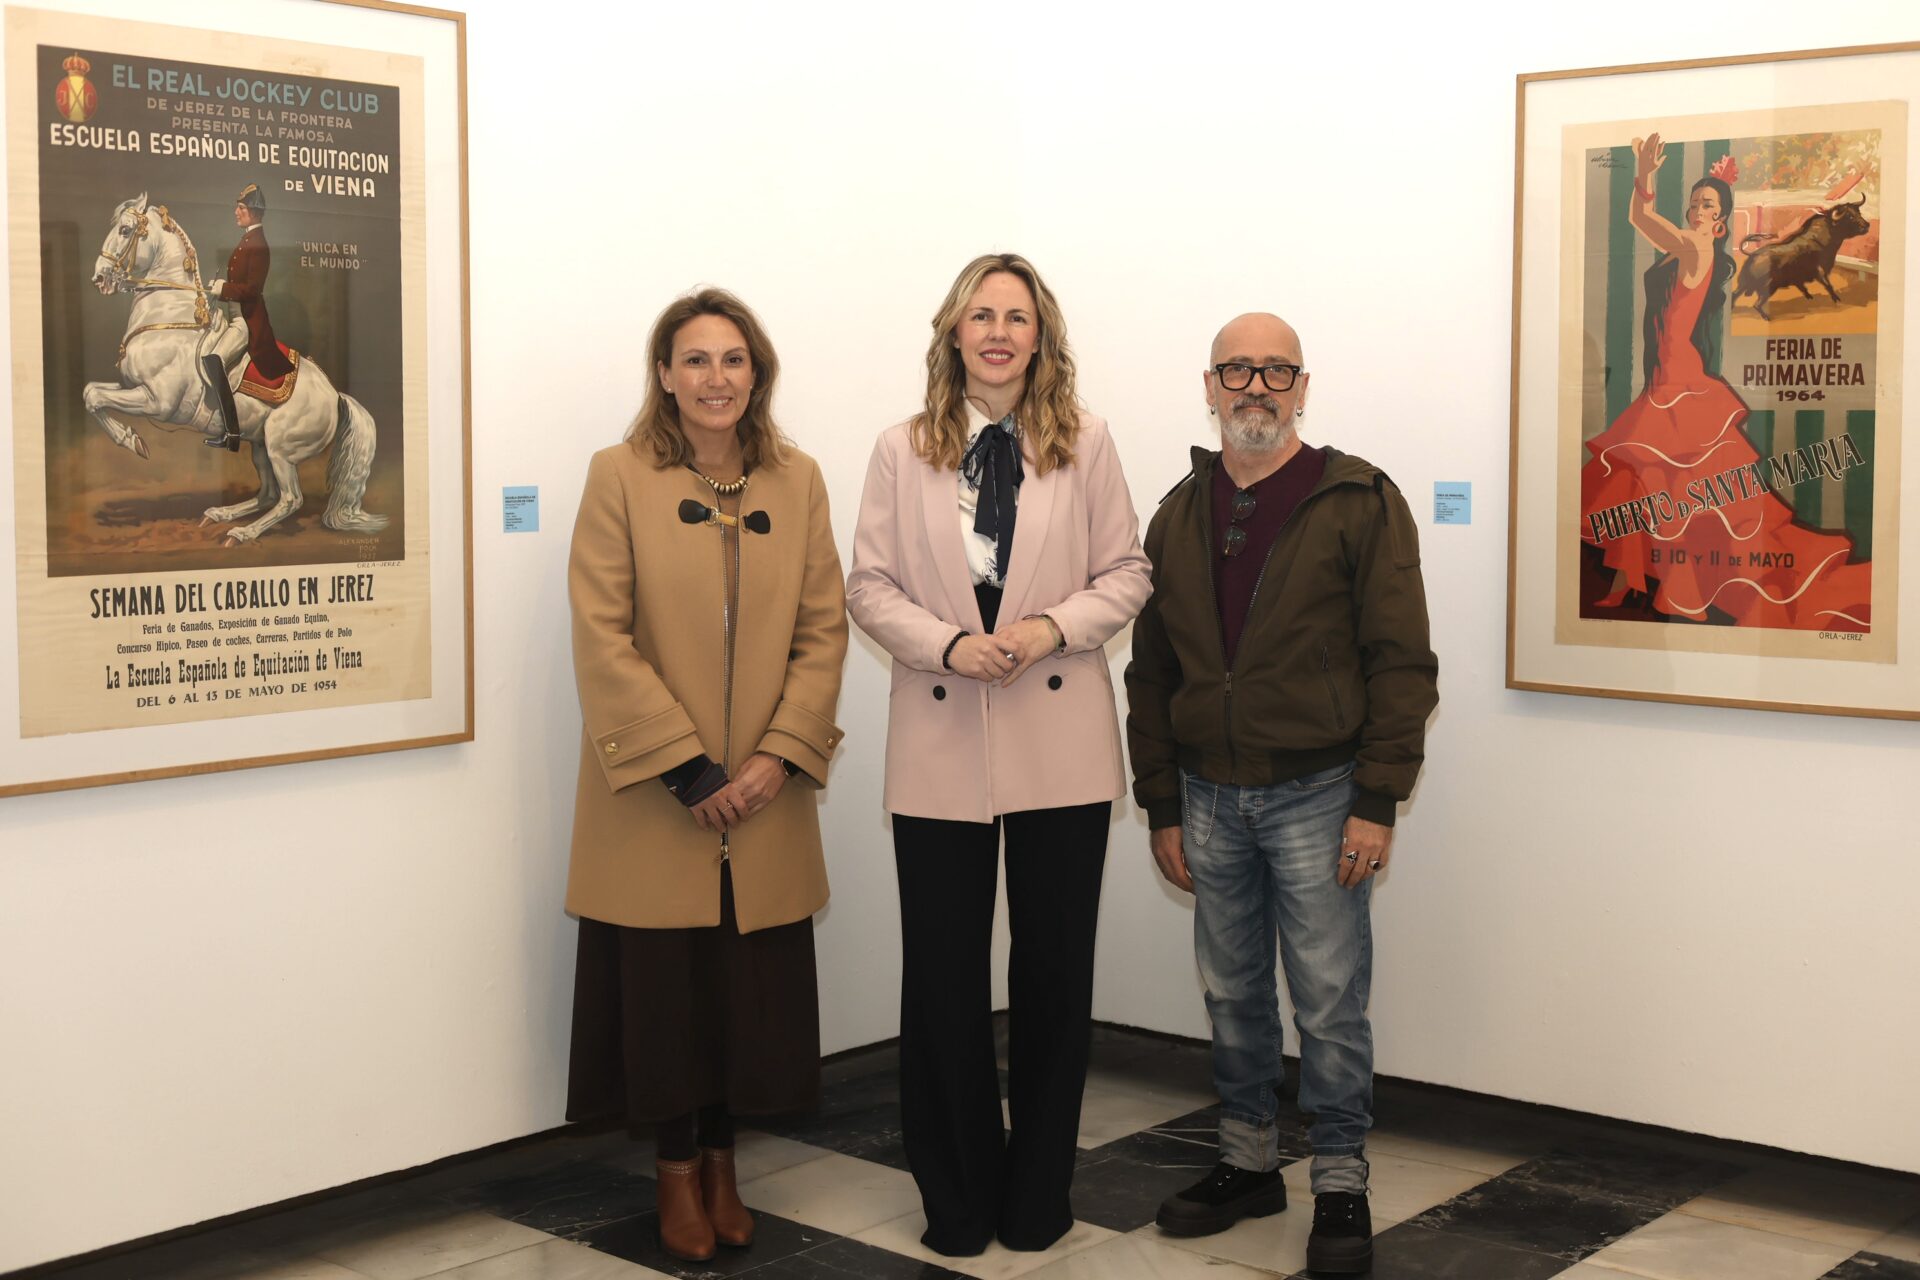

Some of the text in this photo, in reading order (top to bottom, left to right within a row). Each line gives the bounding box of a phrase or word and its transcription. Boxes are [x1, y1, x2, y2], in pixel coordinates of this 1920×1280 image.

[113, 64, 379, 114] EL REAL JOCKEY CLUB
[147, 97, 353, 129] DE JEREZ DE LA FRONTERA
[172, 116, 334, 144] PRESENTA LA FAMOSA
[50, 123, 389, 174] ESCUELA ESPAÑOLA DE EQUITACION
[311, 174, 375, 198] VIENA
[301, 256, 315, 267] EL
[343, 244, 358, 255] EN
[1766, 338, 1842, 360] FERIA DE
[1743, 363, 1865, 386] PRIMAVERA
[1776, 390, 1826, 402] 1964
[1588, 490, 1674, 544] PUERTO
[1686, 462, 1770, 513] SANTA
[1669, 549, 1686, 565] 10
[1728, 556, 1742, 566] DE
[1749, 552, 1794, 568] MAYO
[90, 574, 374, 619] SEMANA DEL CABALLO EN JEREZ
[143, 613, 330, 634] Feria de Ganados, Exposición de Ganado Equino,
[117, 643, 152, 654] Concurso
[186, 637, 208, 649] Paseo
[212, 637, 221, 647] de
[226, 635, 252, 647] coches,
[256, 633, 289, 644] Carreras,
[293, 630, 321, 641] Partidos
[325, 628, 334, 638] de
[337, 627, 353, 638] Polo
[1818, 632, 1863, 641] ORLA-JEREZ
[106, 646, 363, 689] La Escuela Española de Equitación de Viena
[137, 696, 161, 708] DEL
[168, 695, 176, 705] 6
[184, 692, 199, 704] AL
[225, 688, 242, 700] DE
[249, 684, 284, 697] MAYO
[291, 682, 308, 694] DE
[314, 680, 337, 691] 1954
